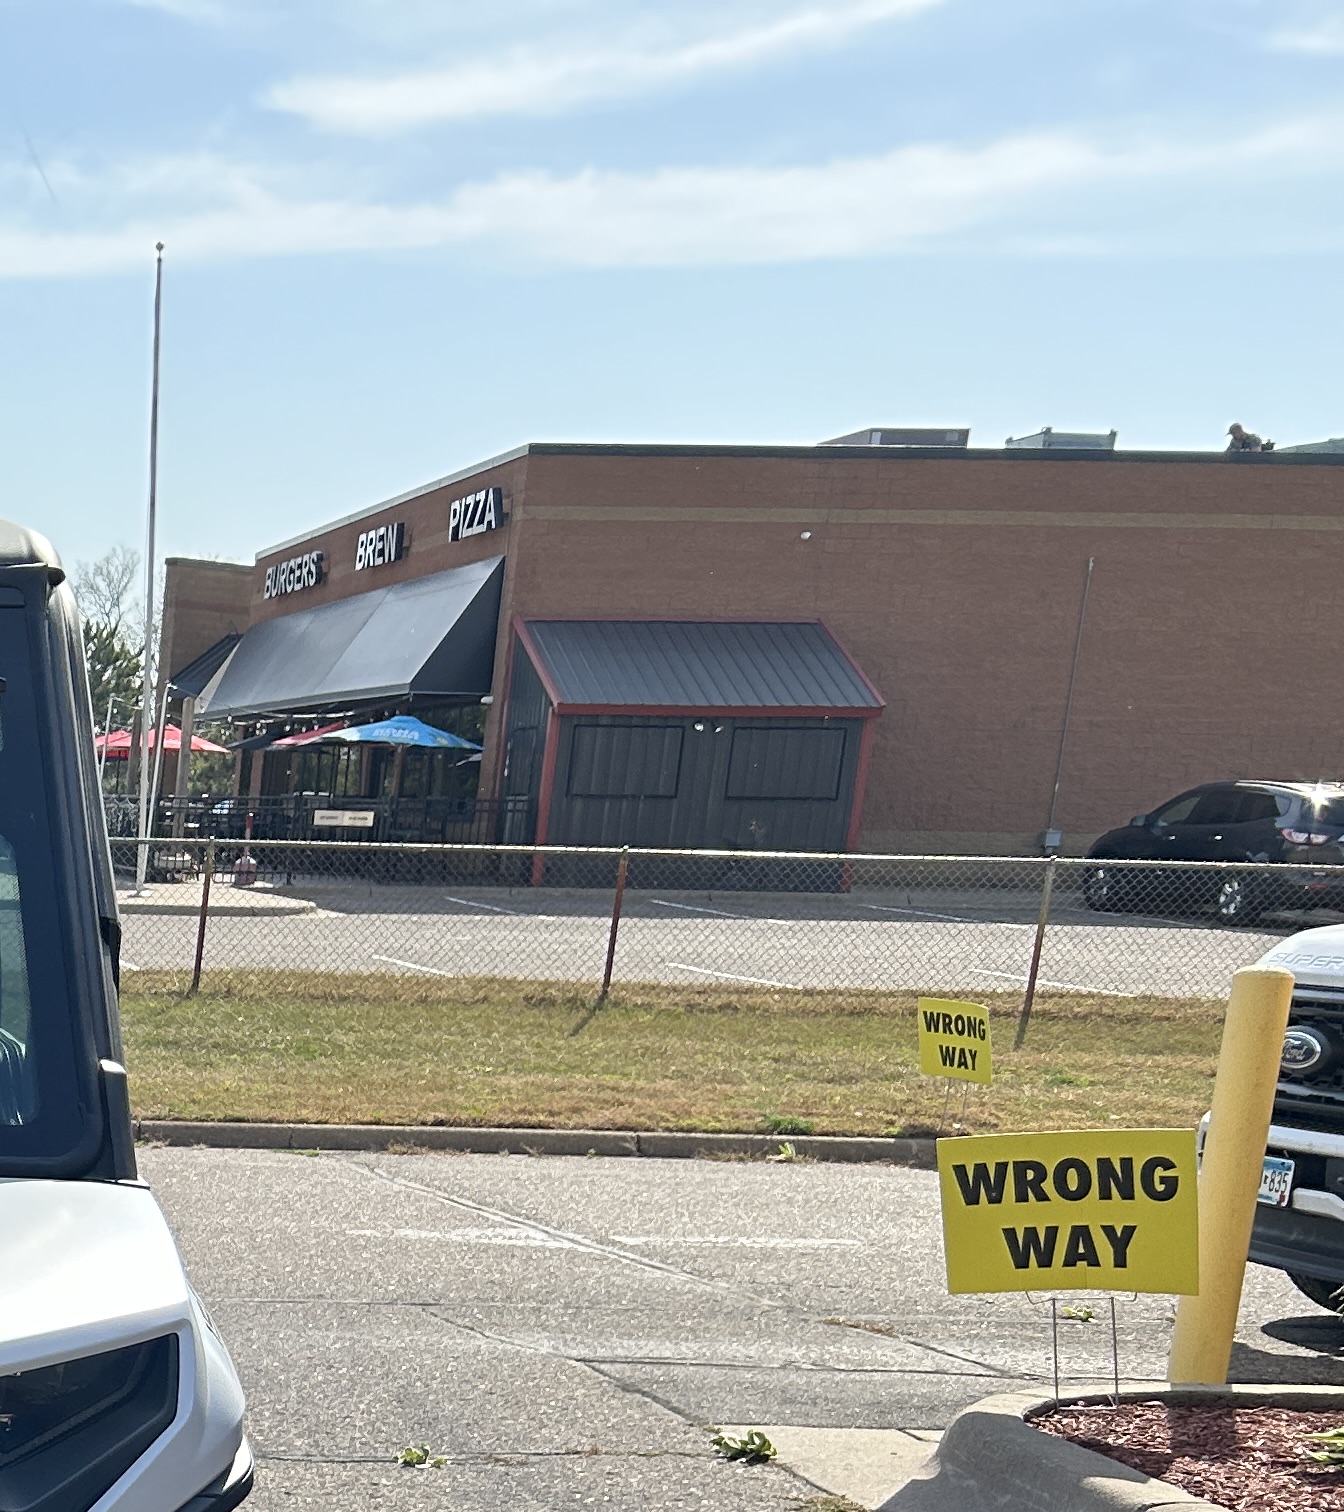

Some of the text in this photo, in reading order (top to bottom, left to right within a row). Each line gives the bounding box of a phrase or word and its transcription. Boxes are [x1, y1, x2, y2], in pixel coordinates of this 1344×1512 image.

[263, 487, 499, 599] BURGERS BREW PIZZA
[1269, 952, 1344, 970] SUPER
[922, 1010, 986, 1041] WRONG
[938, 1044, 978, 1071] WAY
[1281, 1038, 1308, 1060] Ford
[952, 1156, 1179, 1206] WRONG
[1268, 1170, 1289, 1195] 835
[1001, 1224, 1138, 1270] WAY
